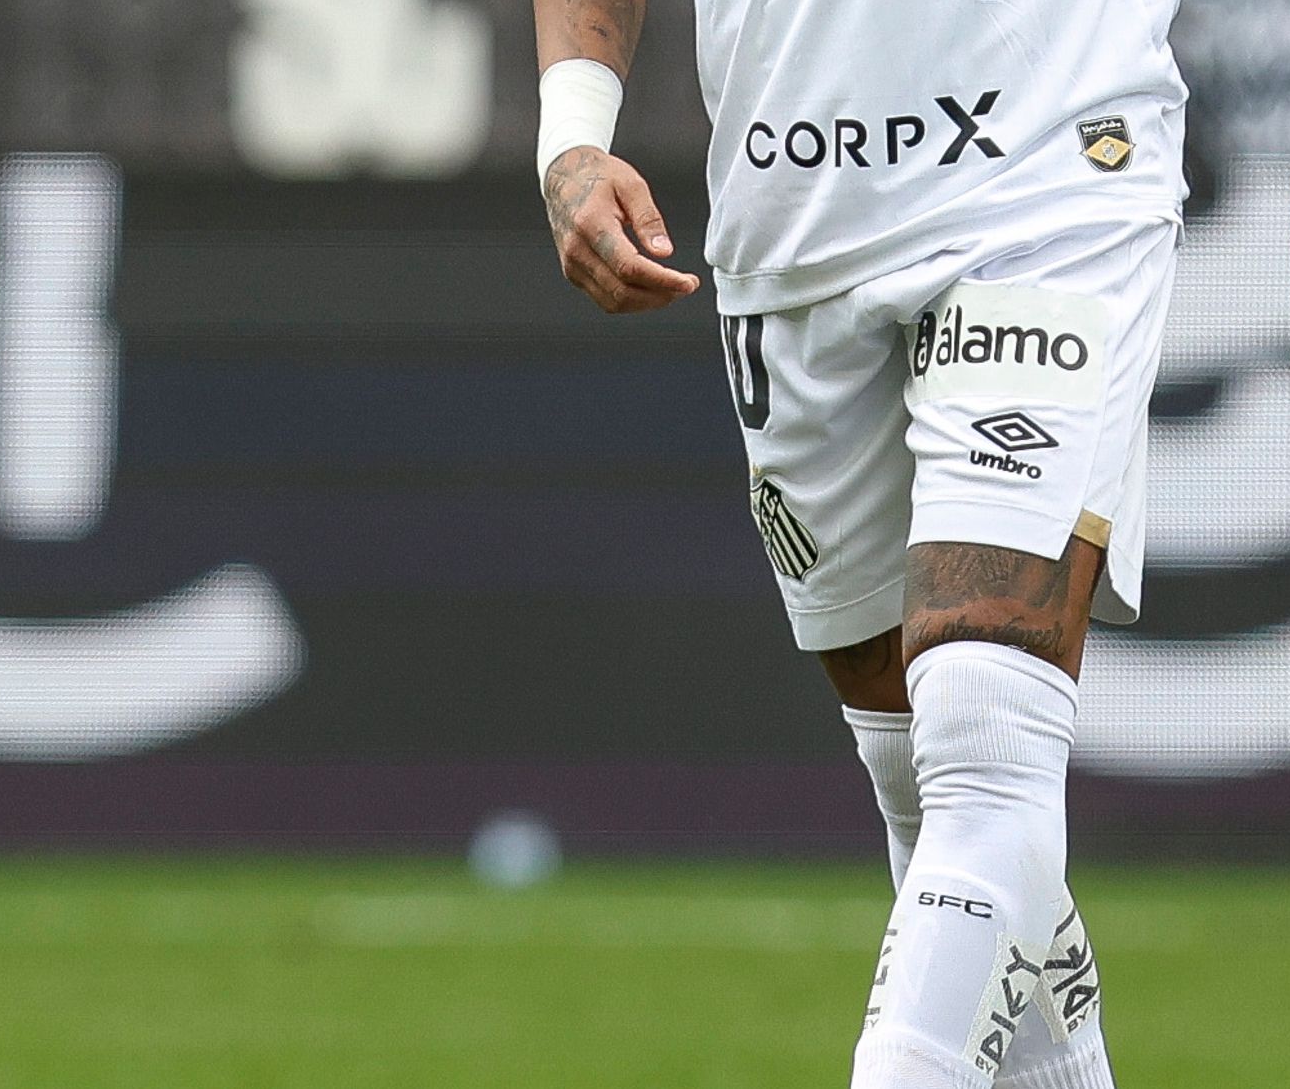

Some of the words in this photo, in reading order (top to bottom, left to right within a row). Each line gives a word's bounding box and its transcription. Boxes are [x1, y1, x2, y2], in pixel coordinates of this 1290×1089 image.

[936, 304, 1089, 371] álamo
[970, 449, 1042, 480] umbro
[918, 891, 993, 919] SFC
